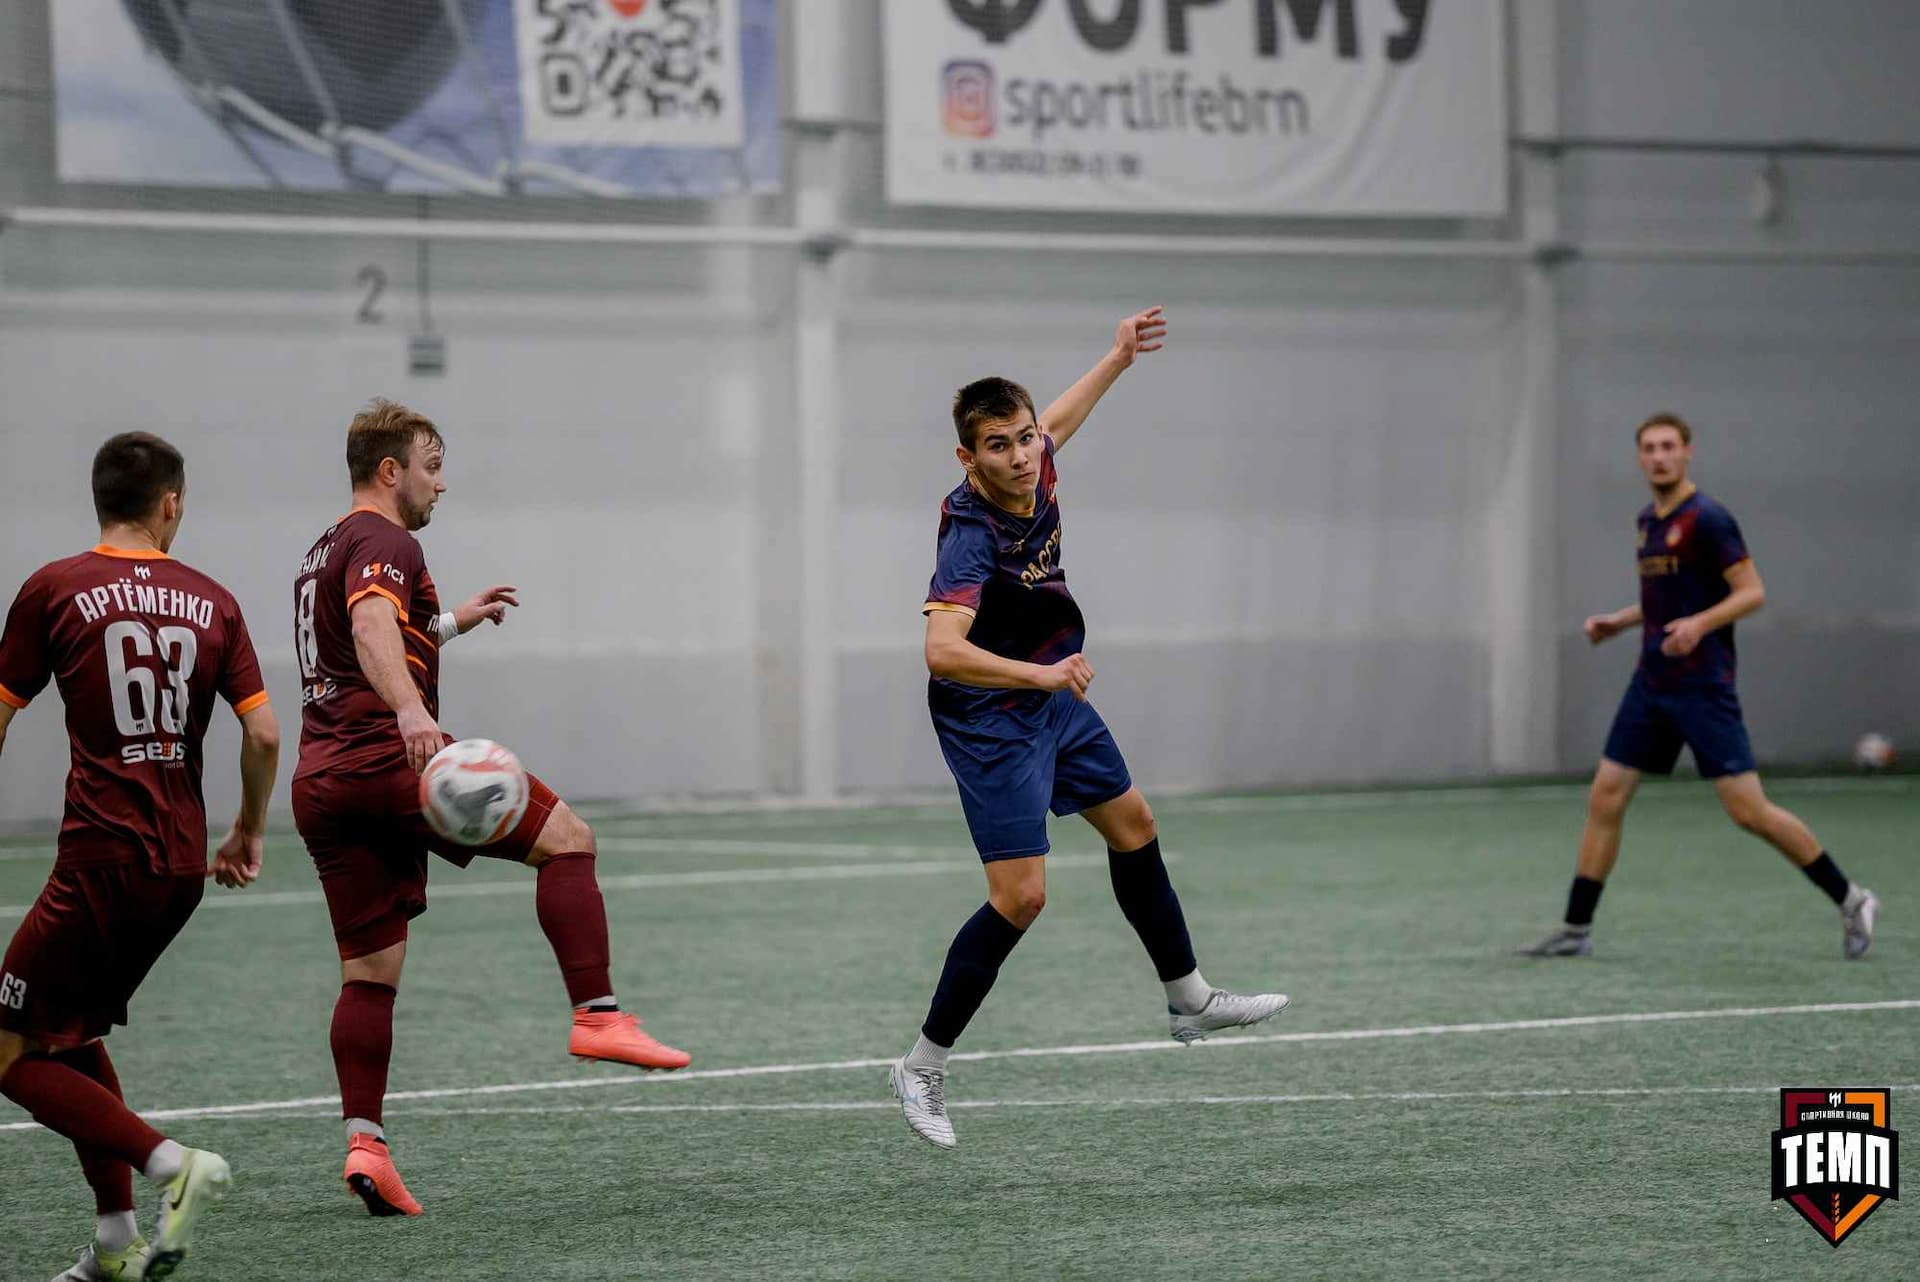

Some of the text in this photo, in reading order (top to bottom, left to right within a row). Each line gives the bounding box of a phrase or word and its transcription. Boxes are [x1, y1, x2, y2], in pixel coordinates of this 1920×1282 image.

[355, 264, 387, 326] 2
[74, 578, 214, 630] АРТЁМЕНКО
[104, 620, 197, 736] 63
[0, 971, 27, 1010] 63
